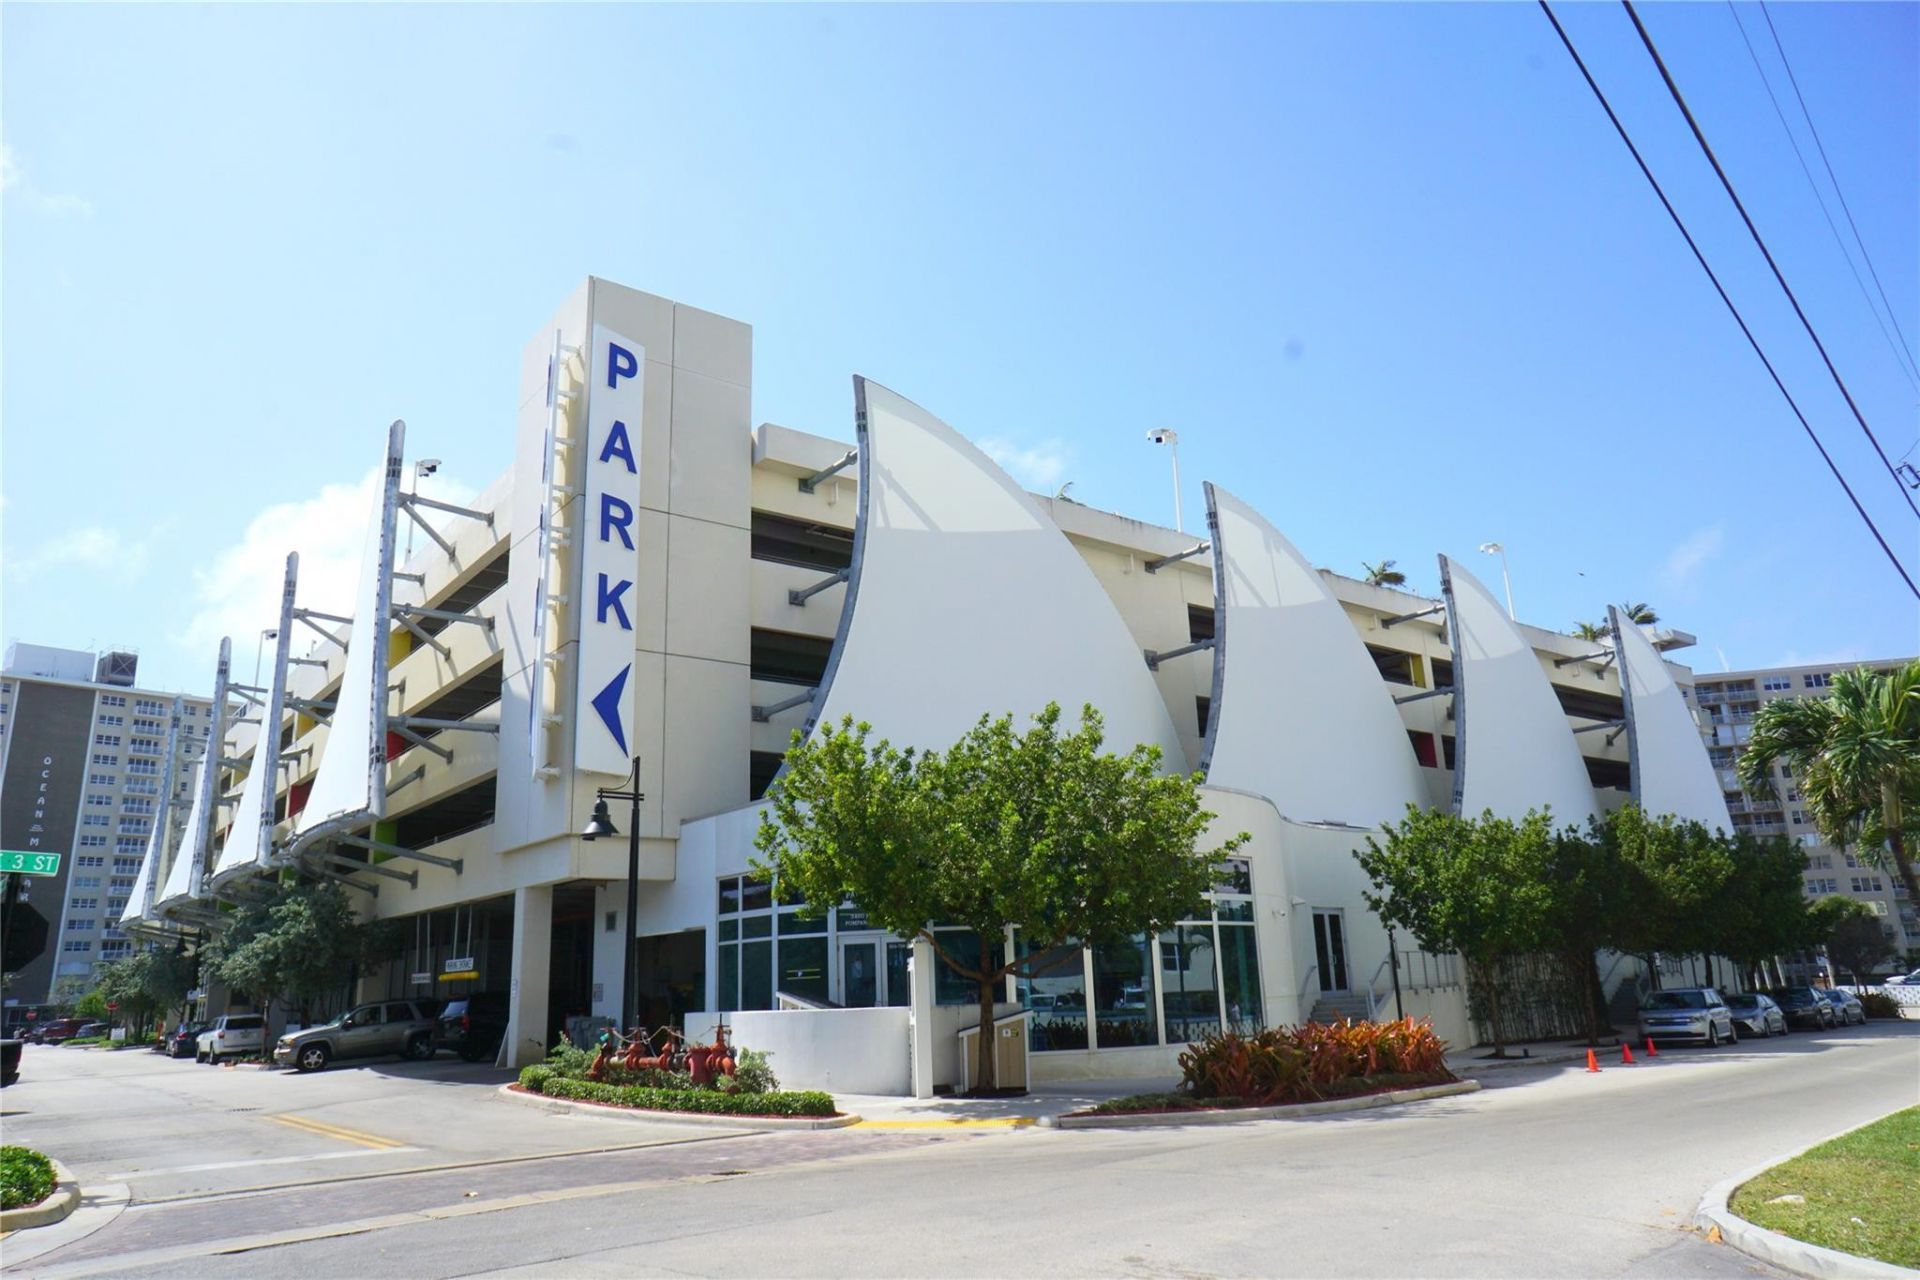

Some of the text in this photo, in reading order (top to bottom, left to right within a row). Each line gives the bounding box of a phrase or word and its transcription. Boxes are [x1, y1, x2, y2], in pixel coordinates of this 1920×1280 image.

[597, 341, 638, 631] PARK
[35, 756, 52, 818] OCEAN
[12, 854, 24, 869] 3
[33, 855, 56, 871] ST
